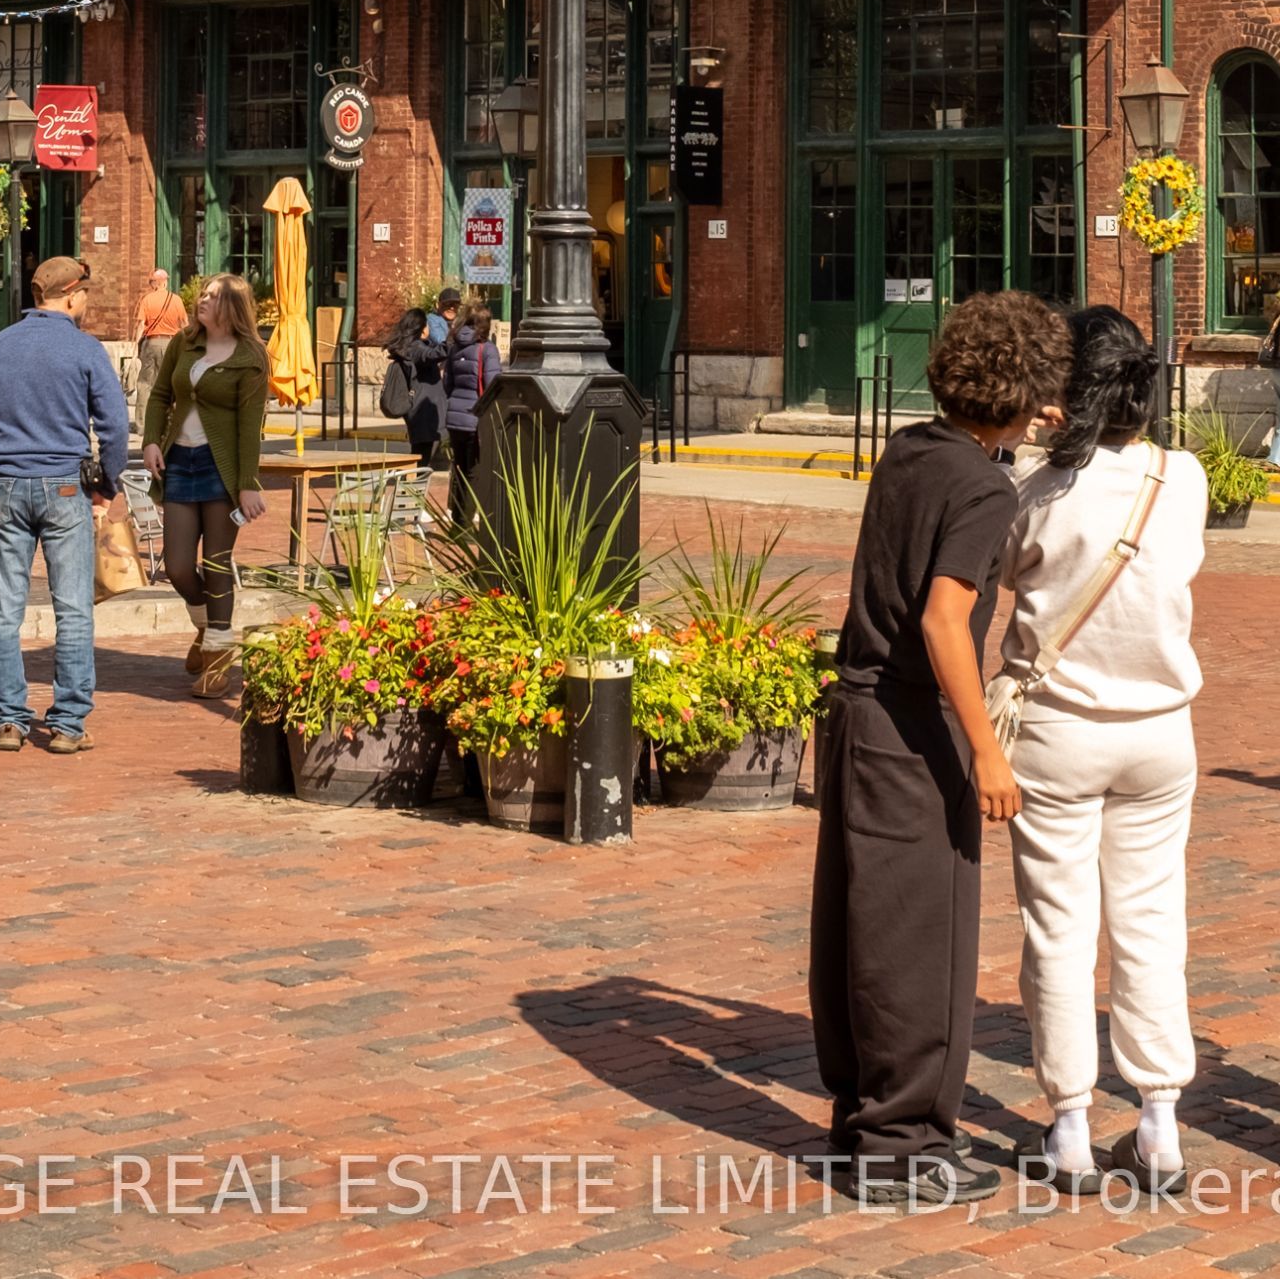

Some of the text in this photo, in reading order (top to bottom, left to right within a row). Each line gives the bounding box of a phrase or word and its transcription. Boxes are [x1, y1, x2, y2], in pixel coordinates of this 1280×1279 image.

[329, 87, 370, 109] RED CANOE
[334, 135, 364, 148] CANADA
[329, 155, 365, 169] OUTFITTER
[380, 226, 388, 237] 17
[467, 221, 503, 232] Polka &
[716, 223, 725, 235] 15
[1105, 219, 1116, 232] 13
[472, 232, 497, 243] Pints
